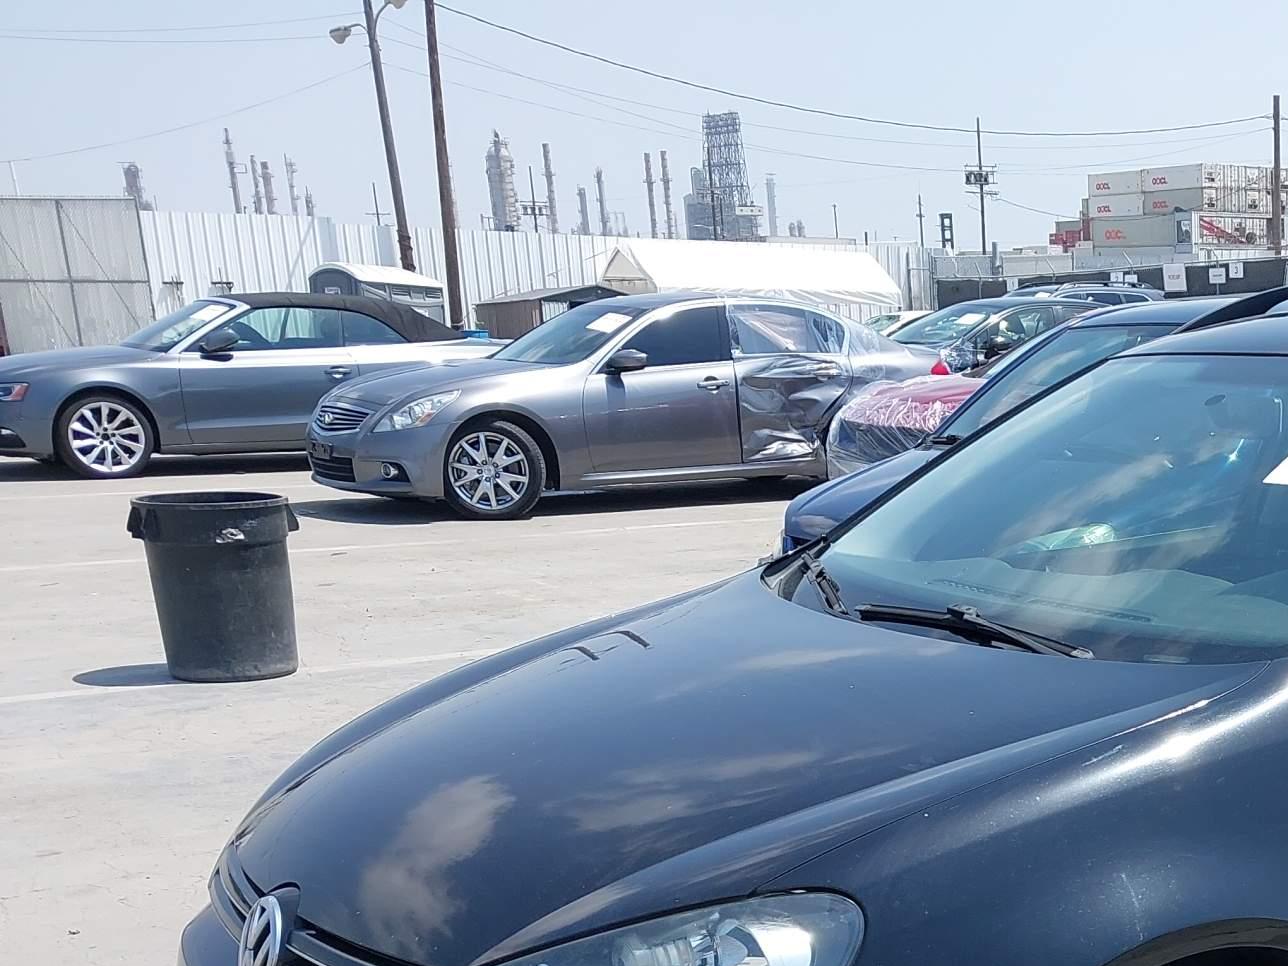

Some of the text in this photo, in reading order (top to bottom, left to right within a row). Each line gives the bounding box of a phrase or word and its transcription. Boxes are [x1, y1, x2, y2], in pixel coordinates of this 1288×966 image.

[1152, 175, 1168, 185] OOCL
[1095, 182, 1111, 191] OOCL
[1096, 204, 1112, 214] OOCL
